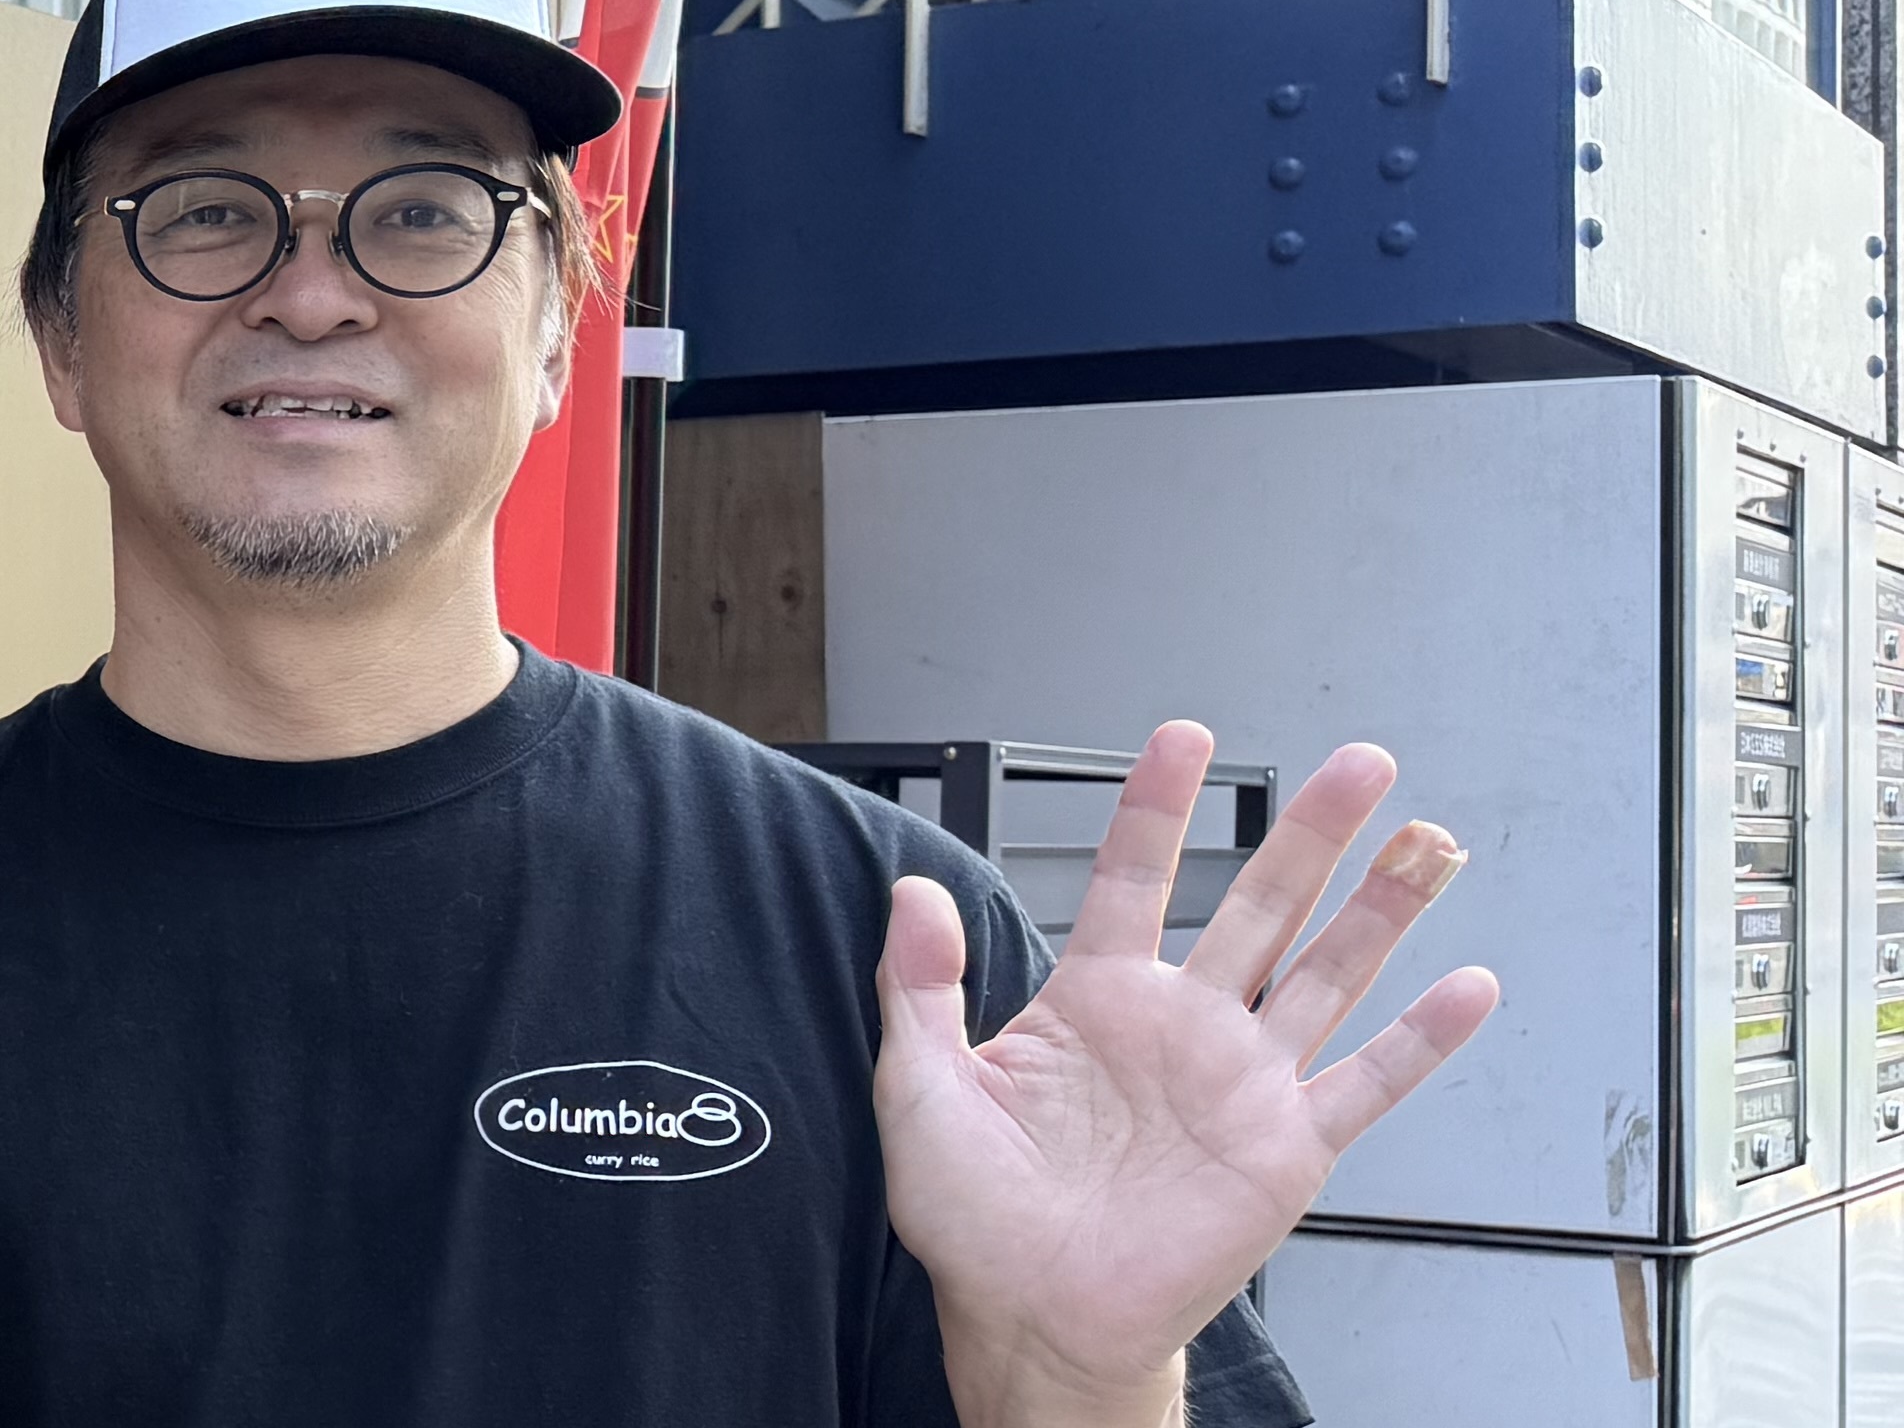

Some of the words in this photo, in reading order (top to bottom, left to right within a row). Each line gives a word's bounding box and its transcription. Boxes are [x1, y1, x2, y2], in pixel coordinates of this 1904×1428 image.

[497, 1096, 680, 1140] Columbia
[585, 1153, 624, 1169] curry
[630, 1153, 661, 1168] rice
